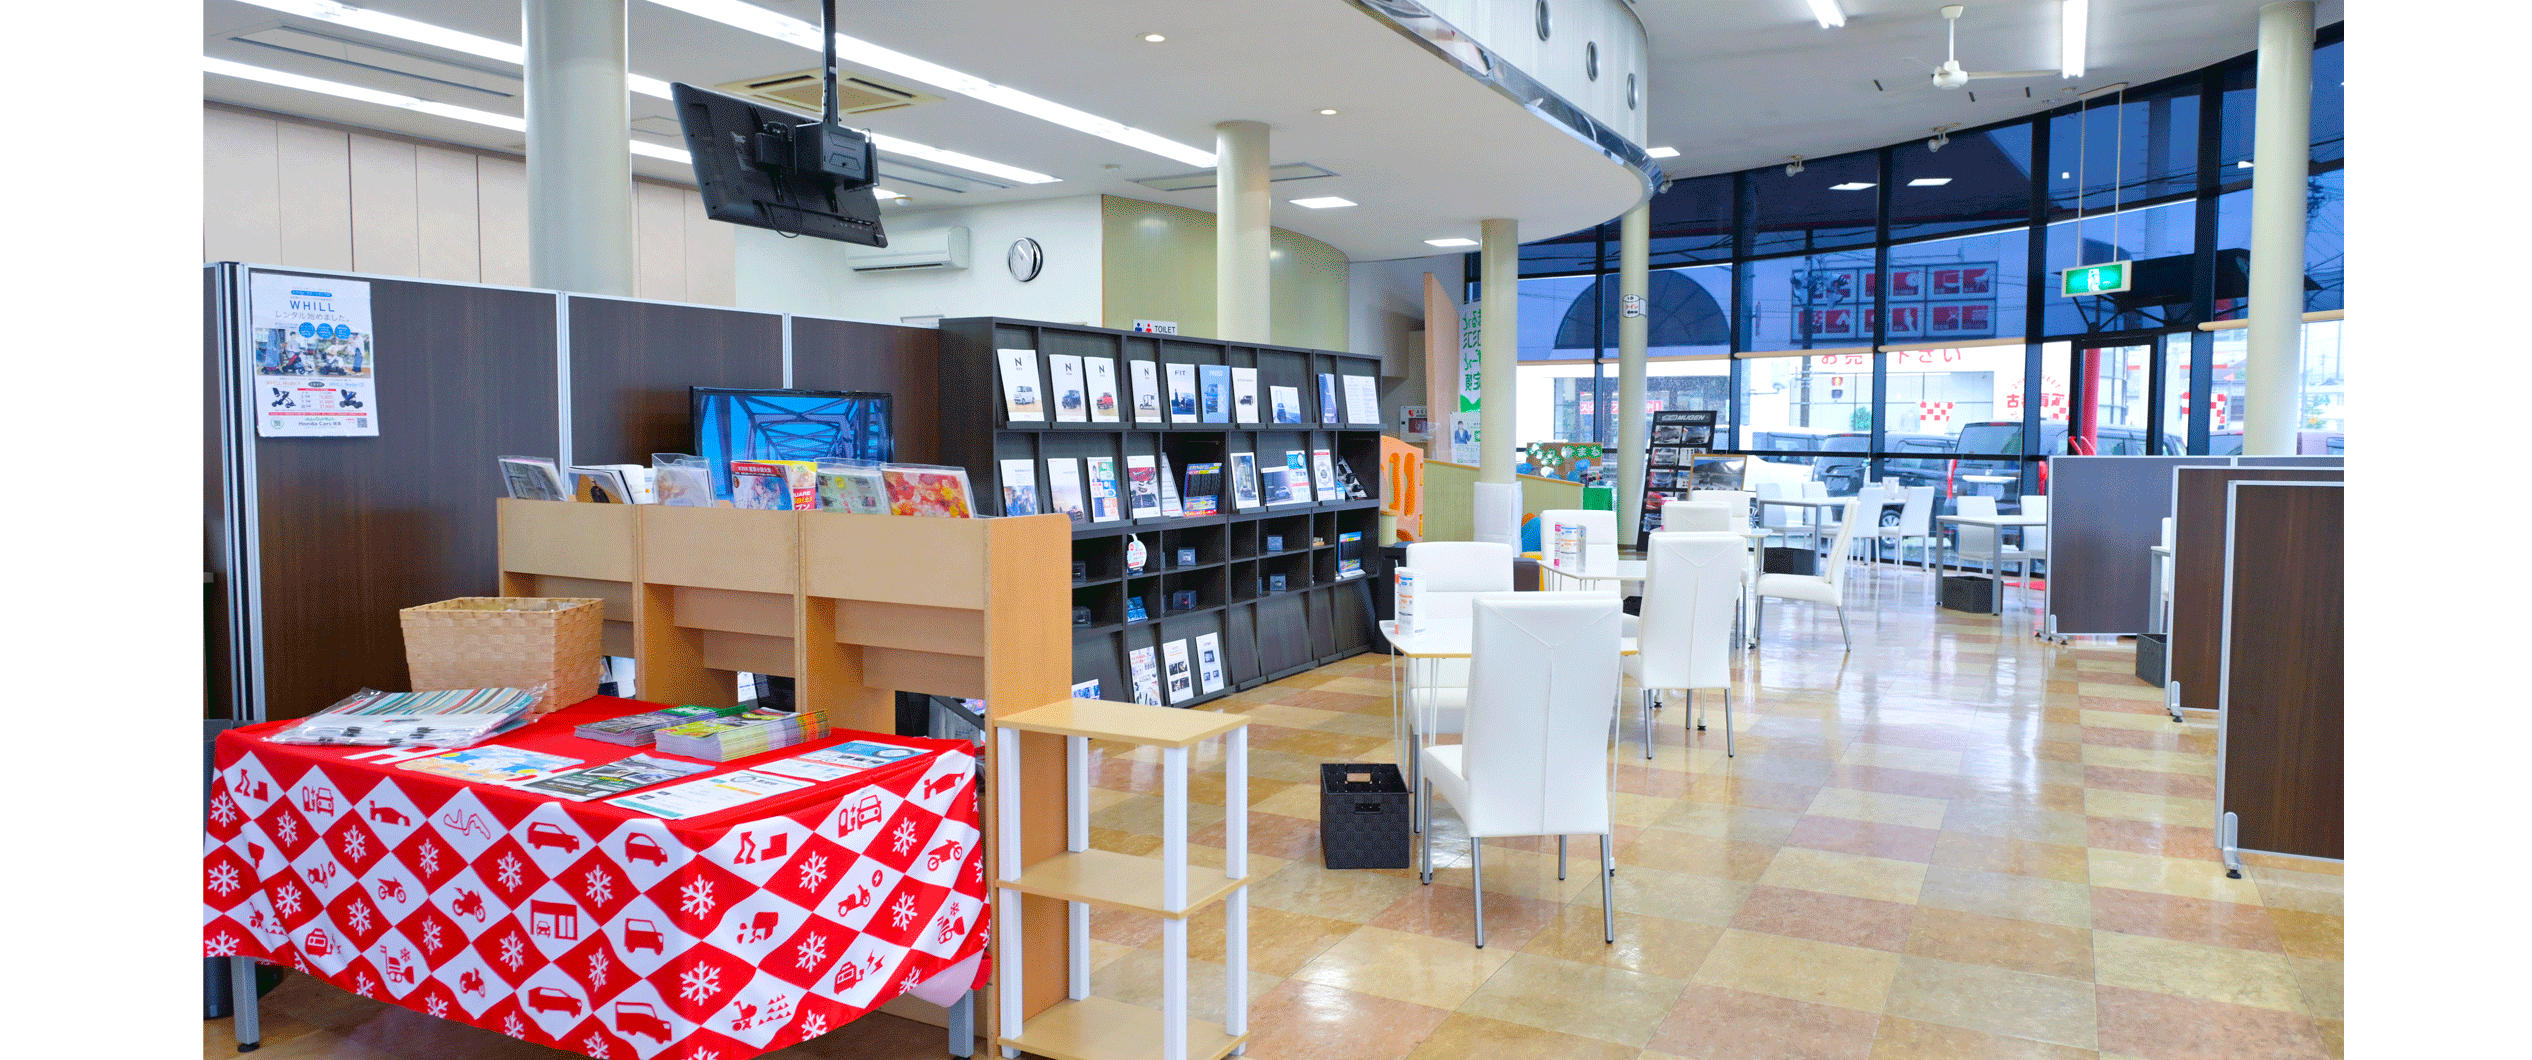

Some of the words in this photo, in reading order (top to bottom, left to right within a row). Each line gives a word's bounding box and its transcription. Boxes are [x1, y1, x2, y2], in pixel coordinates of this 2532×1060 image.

[290, 300, 335, 312] WHILL
[275, 311, 349, 322] レンタル始めました。
[1154, 325, 1176, 333] TOILET
[1014, 357, 1022, 367] N
[1065, 363, 1072, 372] N
[1098, 365, 1105, 374] N
